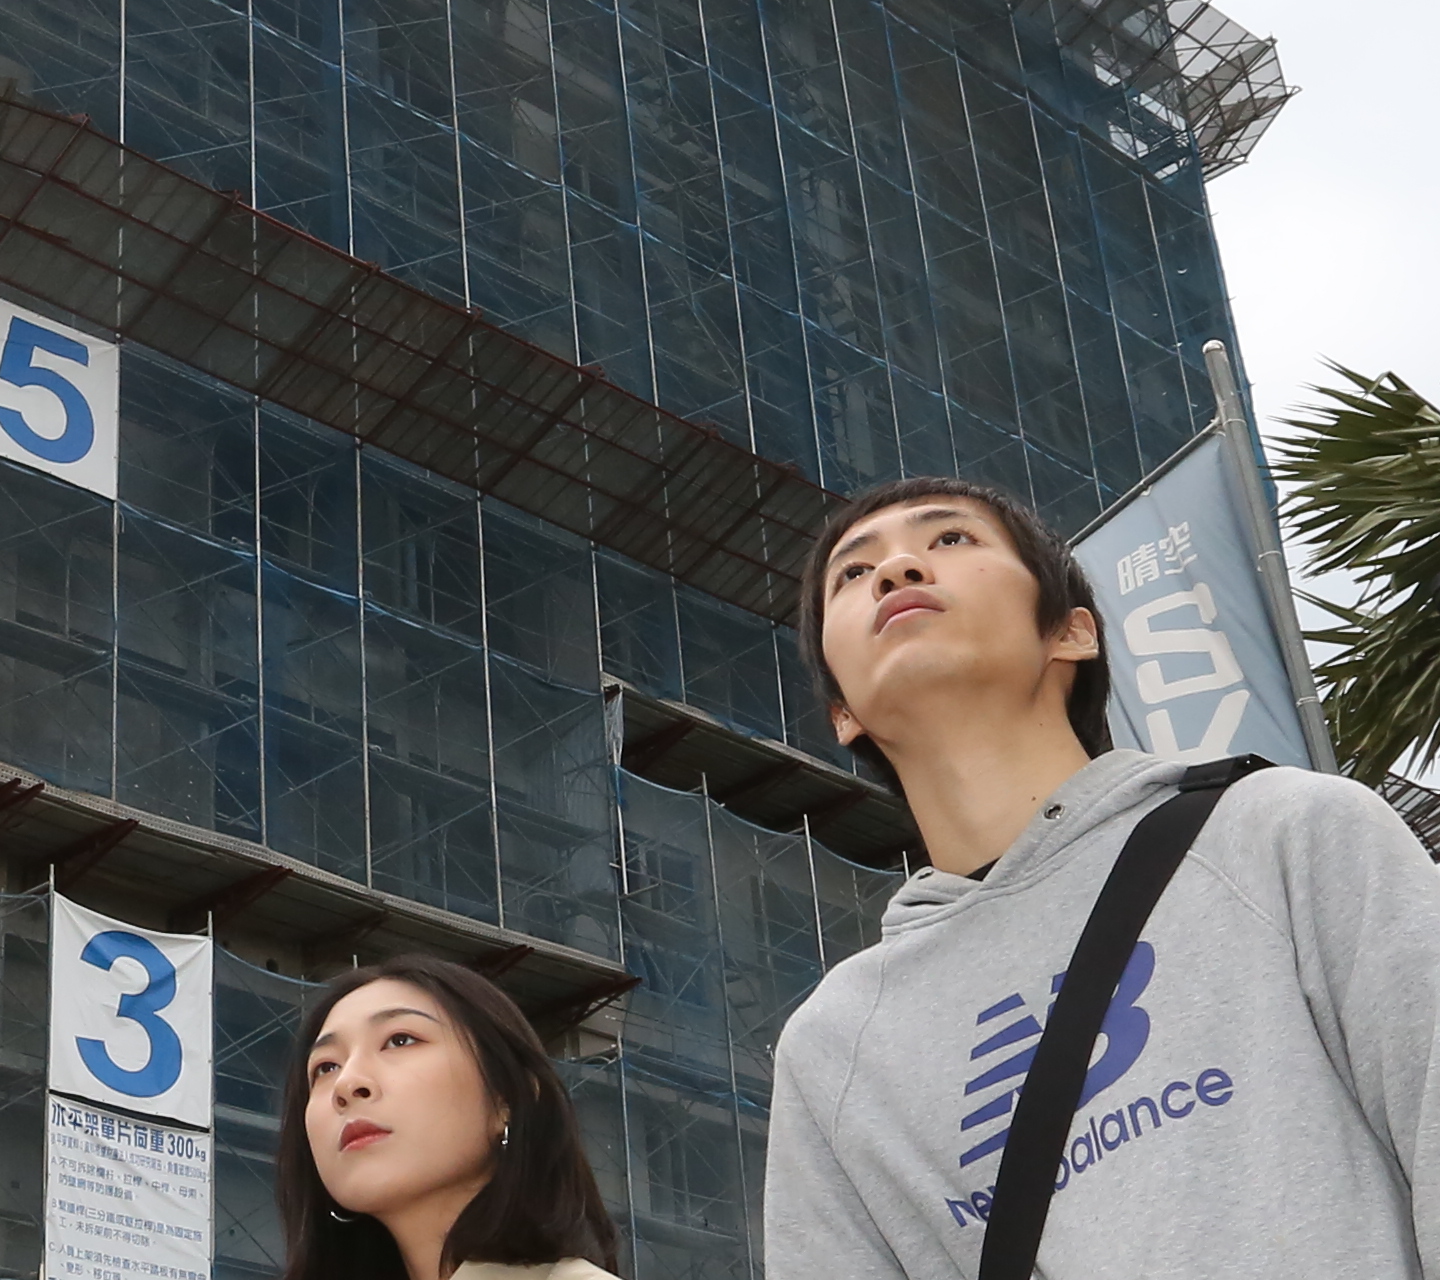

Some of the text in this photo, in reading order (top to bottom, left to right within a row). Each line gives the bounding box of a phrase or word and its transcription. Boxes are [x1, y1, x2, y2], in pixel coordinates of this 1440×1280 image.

[1117, 521, 1198, 596] 晴空
[74, 930, 184, 1098] 3
[51, 1103, 165, 1153] 水平架單片荷重
[944, 1185, 997, 1228] ne
